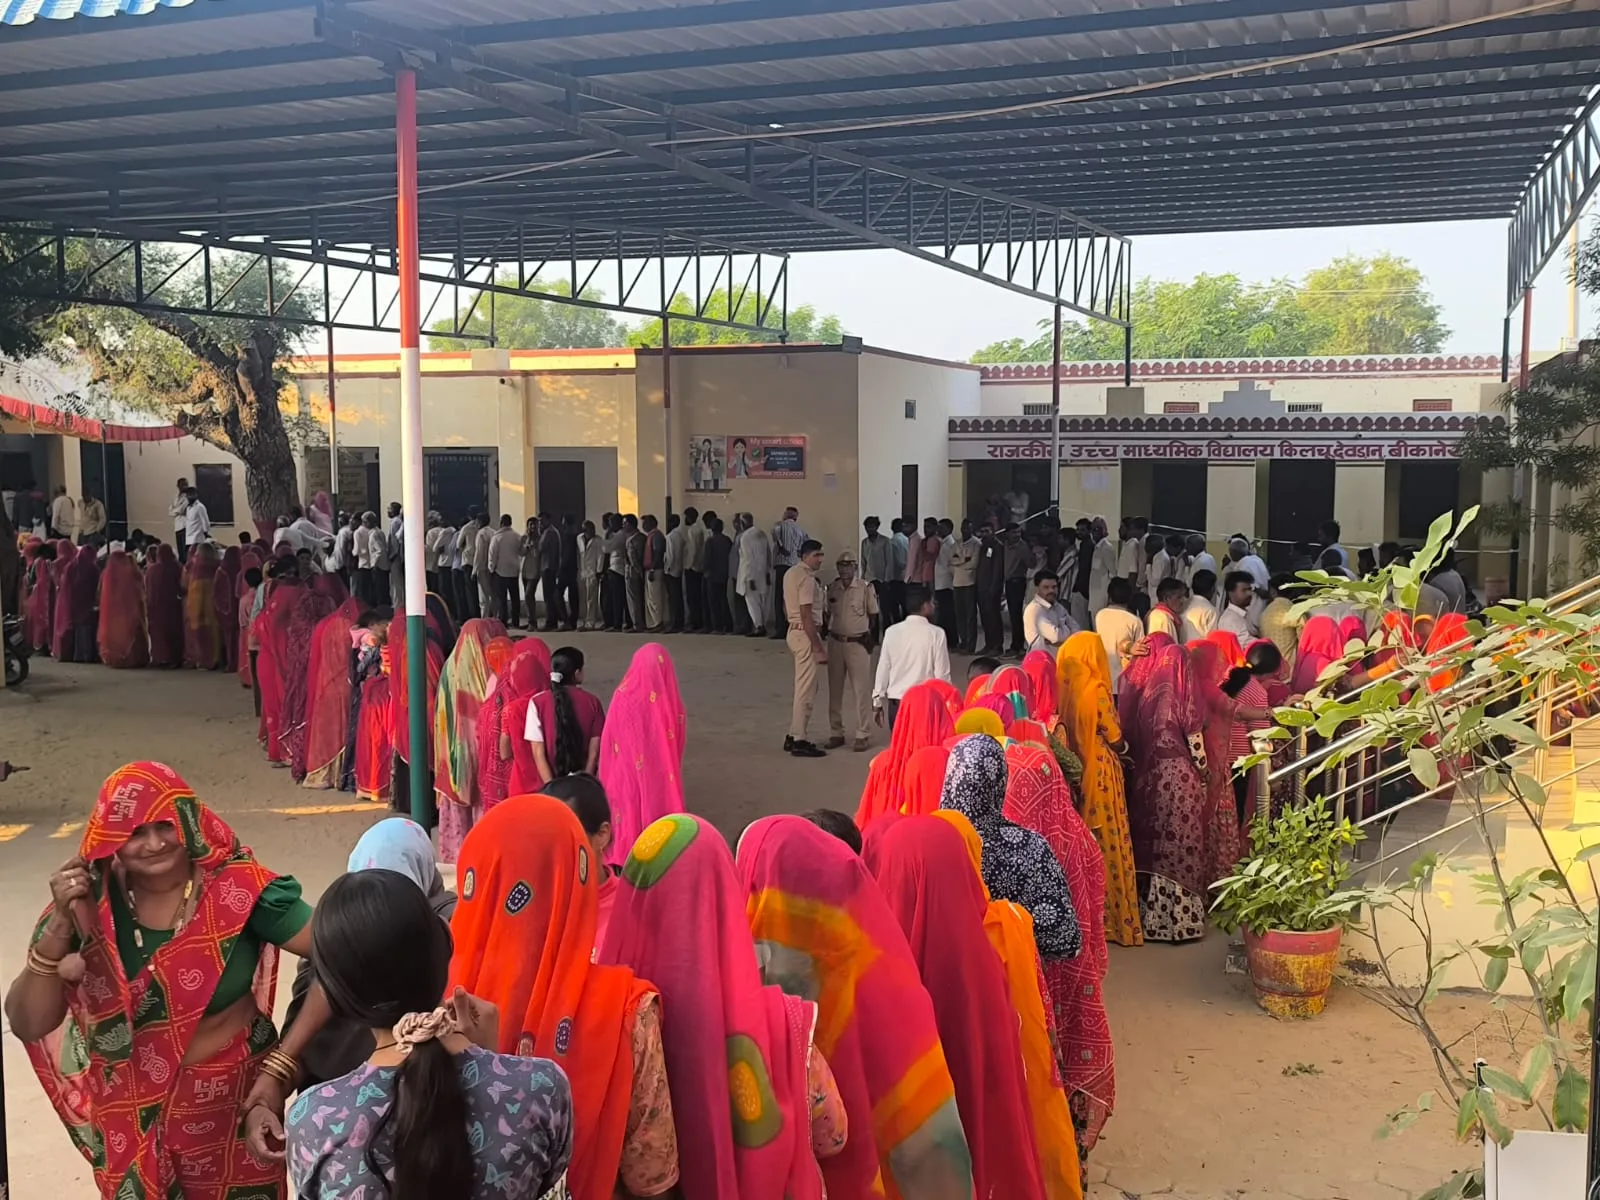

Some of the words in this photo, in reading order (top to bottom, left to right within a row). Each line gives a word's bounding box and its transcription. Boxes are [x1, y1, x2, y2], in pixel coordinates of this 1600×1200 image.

[1070, 444, 1119, 458] उच्च
[1122, 440, 1204, 458] माध्यमिक
[1206, 440, 1276, 458] विद्यालय
[1277, 440, 1334, 461] किलचू
